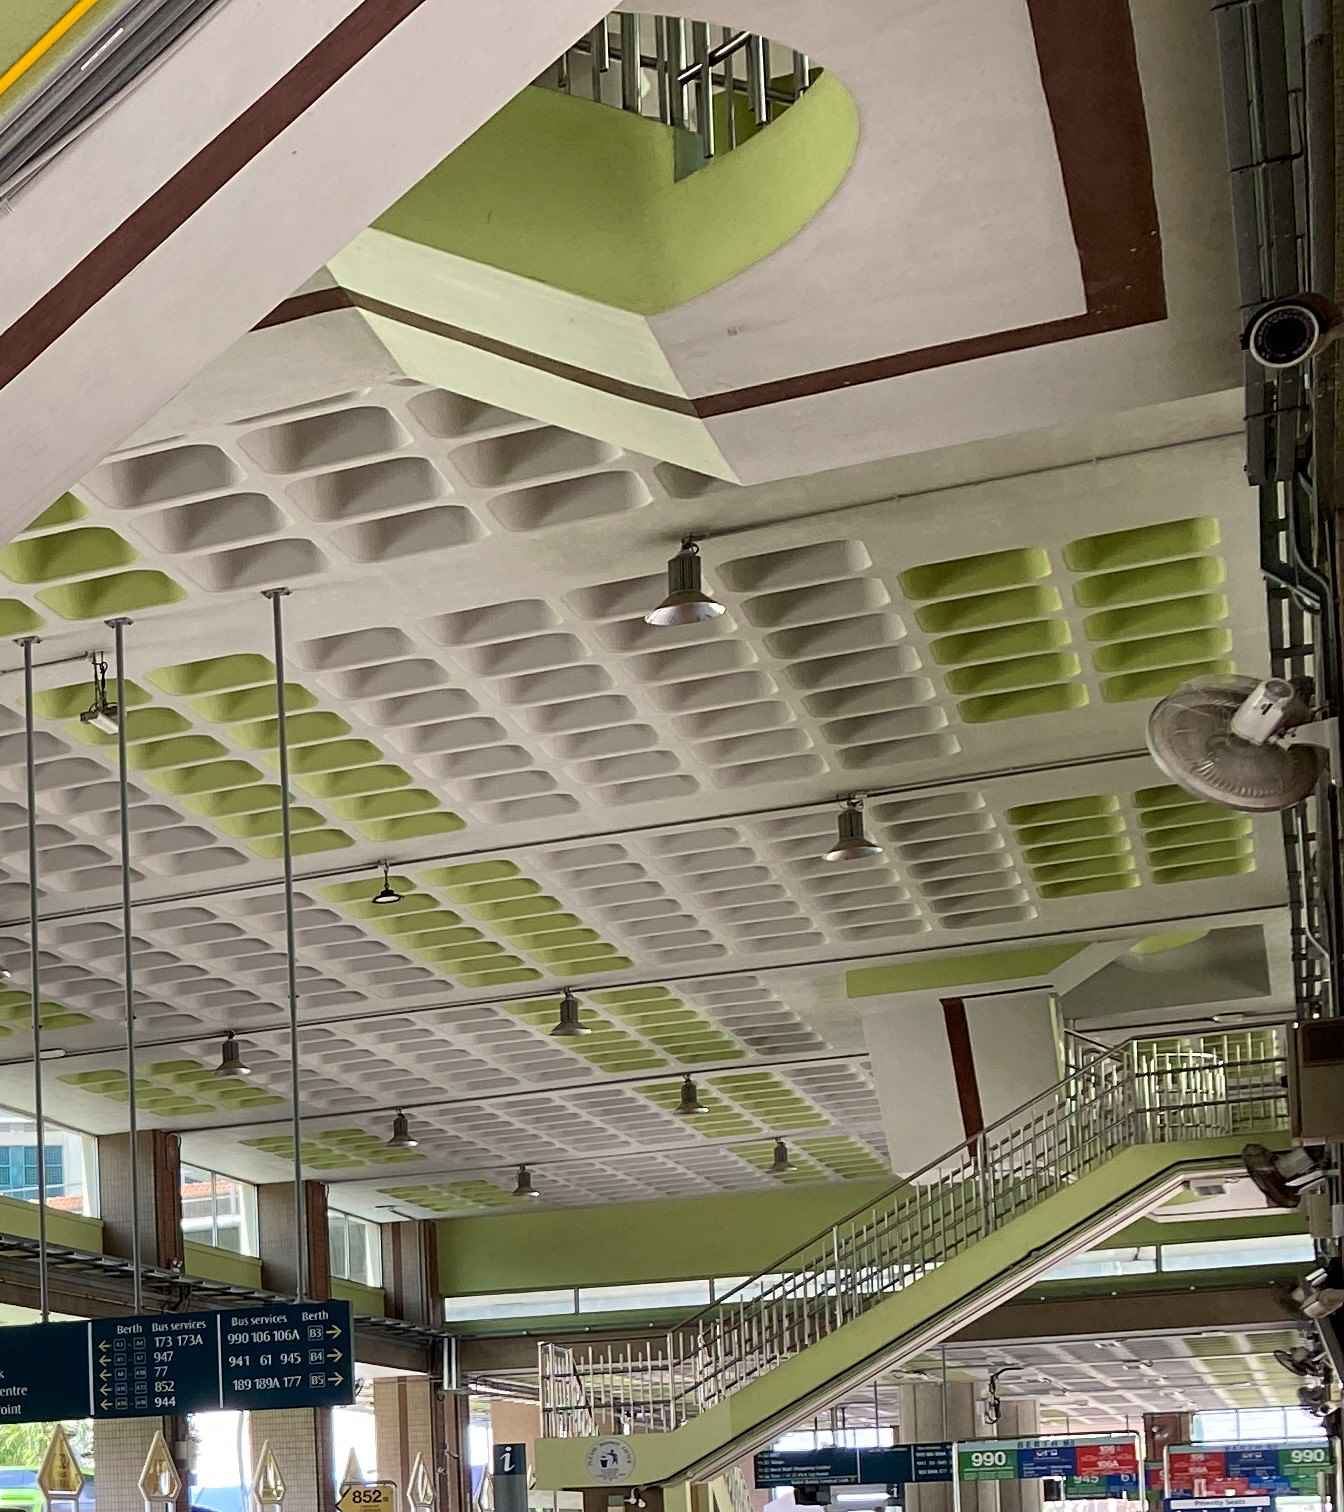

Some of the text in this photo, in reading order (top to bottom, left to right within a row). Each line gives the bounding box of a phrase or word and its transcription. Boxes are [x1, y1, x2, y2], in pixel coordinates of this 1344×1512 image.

[232, 1314, 287, 1327] Bus services
[302, 1311, 329, 1322] Berth
[117, 1323, 143, 1335] Berth
[152, 1318, 207, 1332] Bus services
[154, 1336, 173, 1348] 173
[176, 1335, 203, 1346] 173A
[228, 1329, 300, 1344] 990 106 106A
[153, 1351, 174, 1363] 947
[229, 1353, 302, 1367] 941 61 945
[154, 1366, 168, 1378] 77
[154, 1381, 175, 1393] 852
[232, 1376, 301, 1391] 189 189A 177
[154, 1396, 176, 1408] 944
[971, 1451, 1006, 1467] 990
[1291, 1449, 1325, 1463] 990
[352, 1489, 382, 1504] 852
